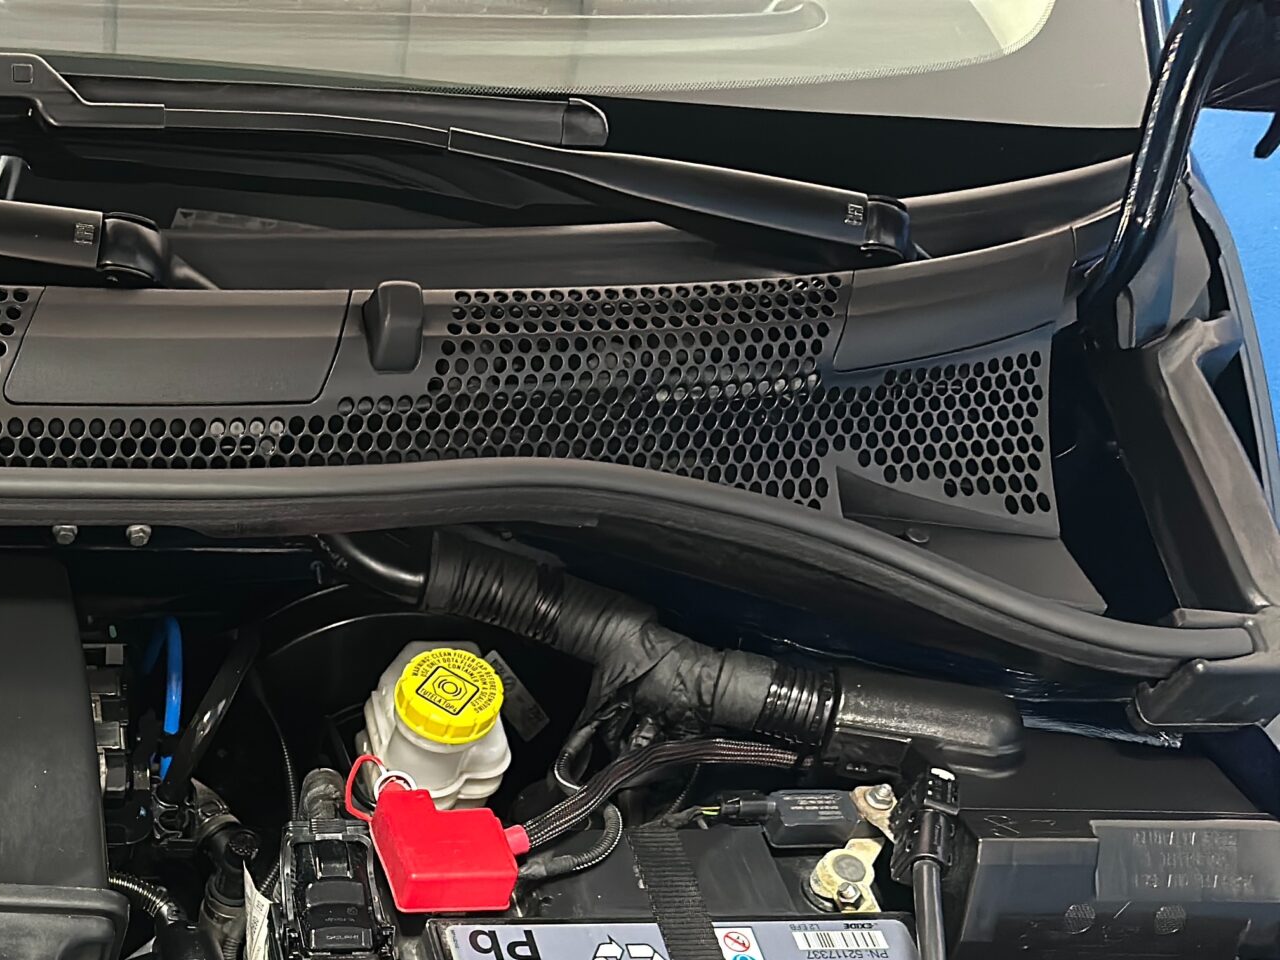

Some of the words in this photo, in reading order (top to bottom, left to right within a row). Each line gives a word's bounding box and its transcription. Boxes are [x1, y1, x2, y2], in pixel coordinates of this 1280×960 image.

[428, 659, 441, 670] ONLY
[460, 659, 478, 671] FLUID
[477, 671, 488, 686] FROM
[431, 651, 452, 659] CLEAN
[454, 652, 476, 664] FILLER
[475, 658, 487, 671] CAP
[486, 670, 497, 692] BEFORE
[448, 663, 480, 683] CONTAINER
[420, 688, 442, 704] TUTELA
[806, 949, 863, 959] 52117337
